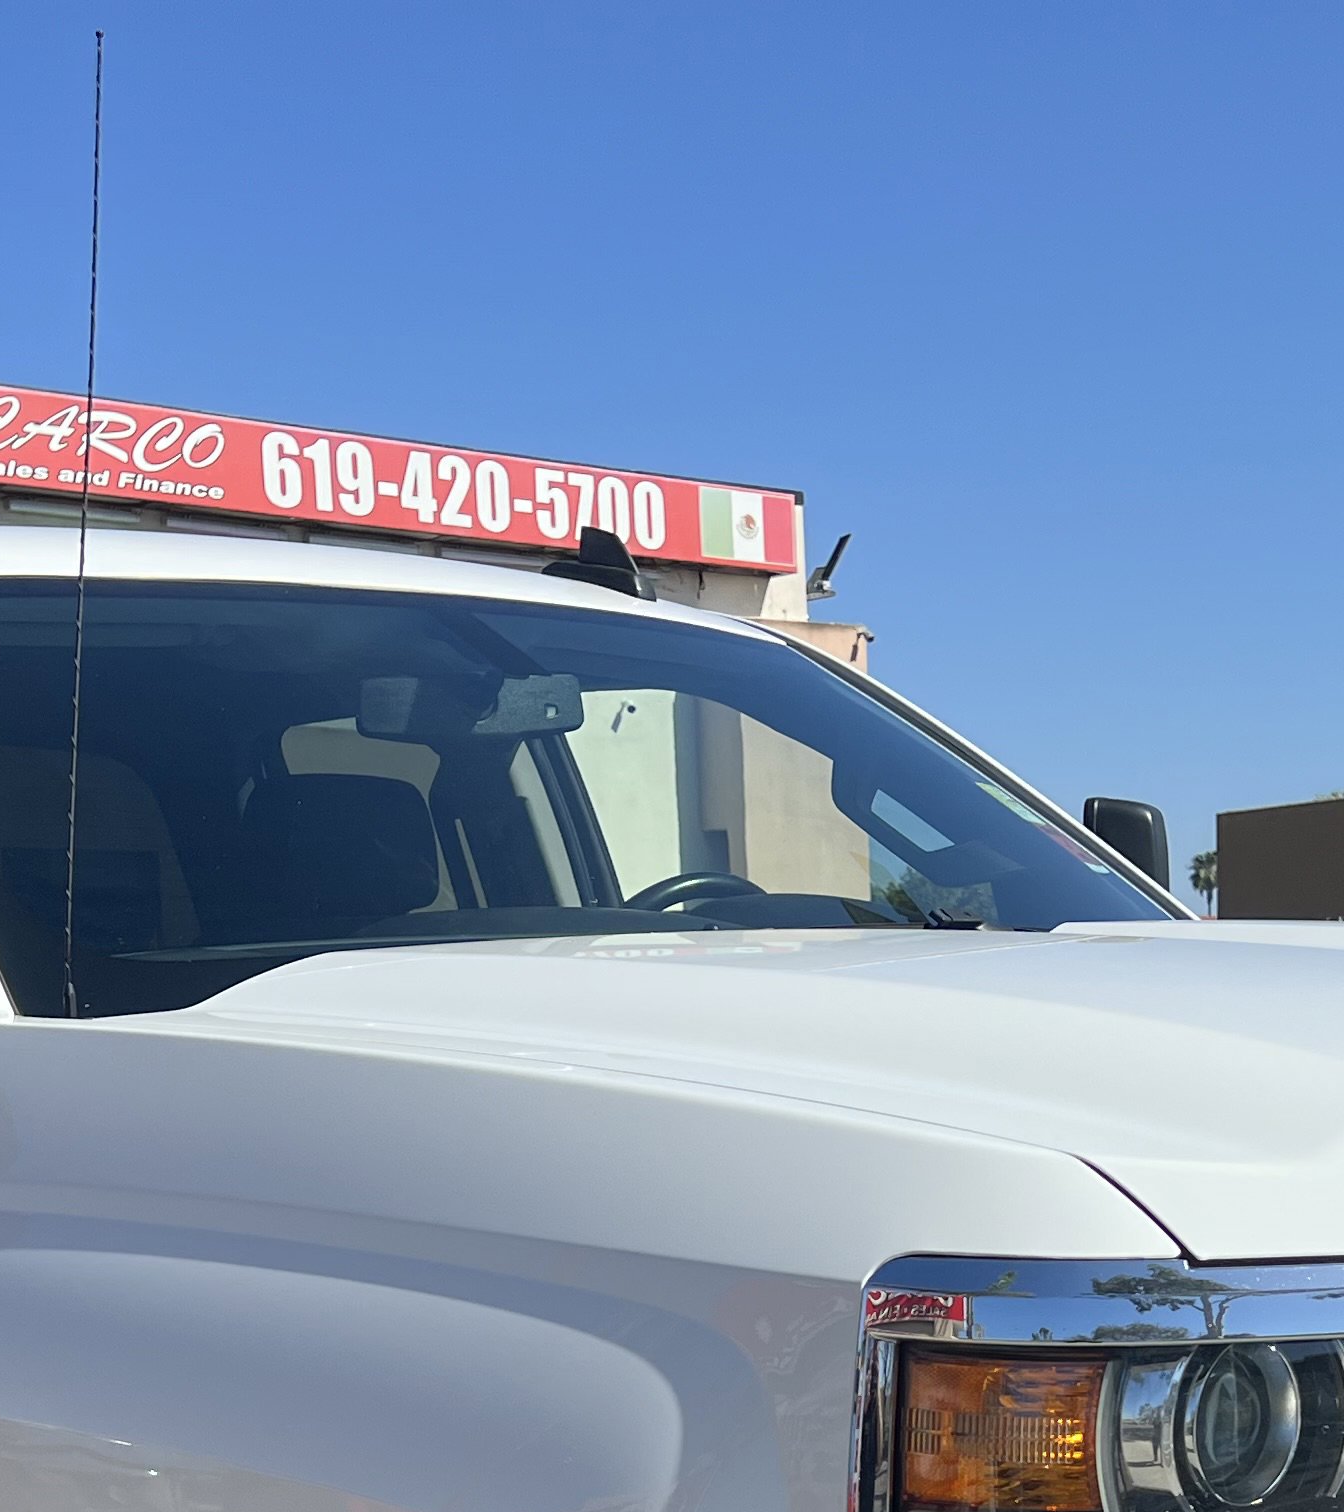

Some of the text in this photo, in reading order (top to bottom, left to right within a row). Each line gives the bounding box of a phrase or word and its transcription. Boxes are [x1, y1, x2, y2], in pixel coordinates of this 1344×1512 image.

[57, 467, 110, 487] and
[117, 471, 225, 500] Finance
[260, 430, 667, 551] 619-420-5700
